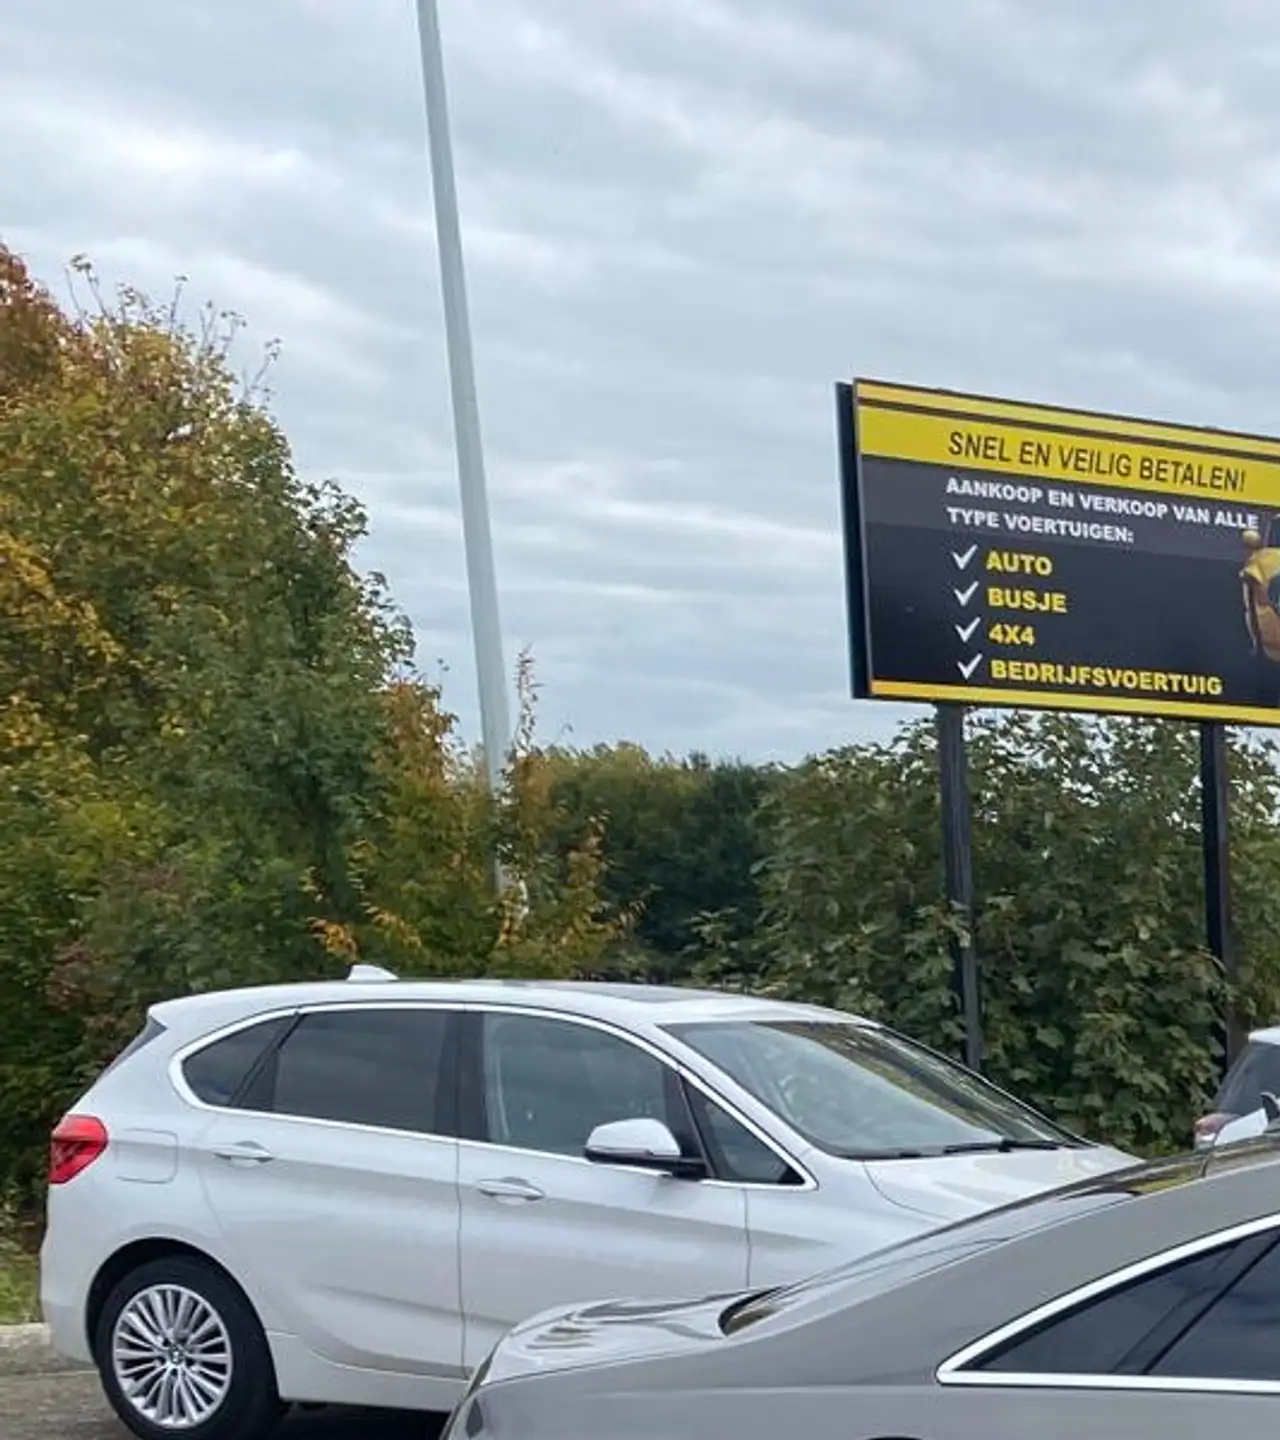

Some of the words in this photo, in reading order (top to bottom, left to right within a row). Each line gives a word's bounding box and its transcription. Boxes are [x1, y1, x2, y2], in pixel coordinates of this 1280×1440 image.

[948, 432, 1011, 462] SNEL
[1020, 442, 1051, 467] EN
[1059, 446, 1131, 477] VEILIG
[1139, 457, 1246, 492] BETALEN!
[946, 477, 1043, 503] AANKOOP
[1048, 489, 1074, 508] EN
[1078, 492, 1168, 519] VERKOOP
[1172, 504, 1209, 524] VAN
[1214, 511, 1259, 529] ALLE
[946, 506, 999, 528] TYPE
[1004, 513, 1134, 543] VOERTUIGEN:
[986, 551, 1052, 576] AUTO
[987, 587, 1067, 613] BUSJE
[991, 659, 1223, 695] BEDRIJFSVOERTUIG
